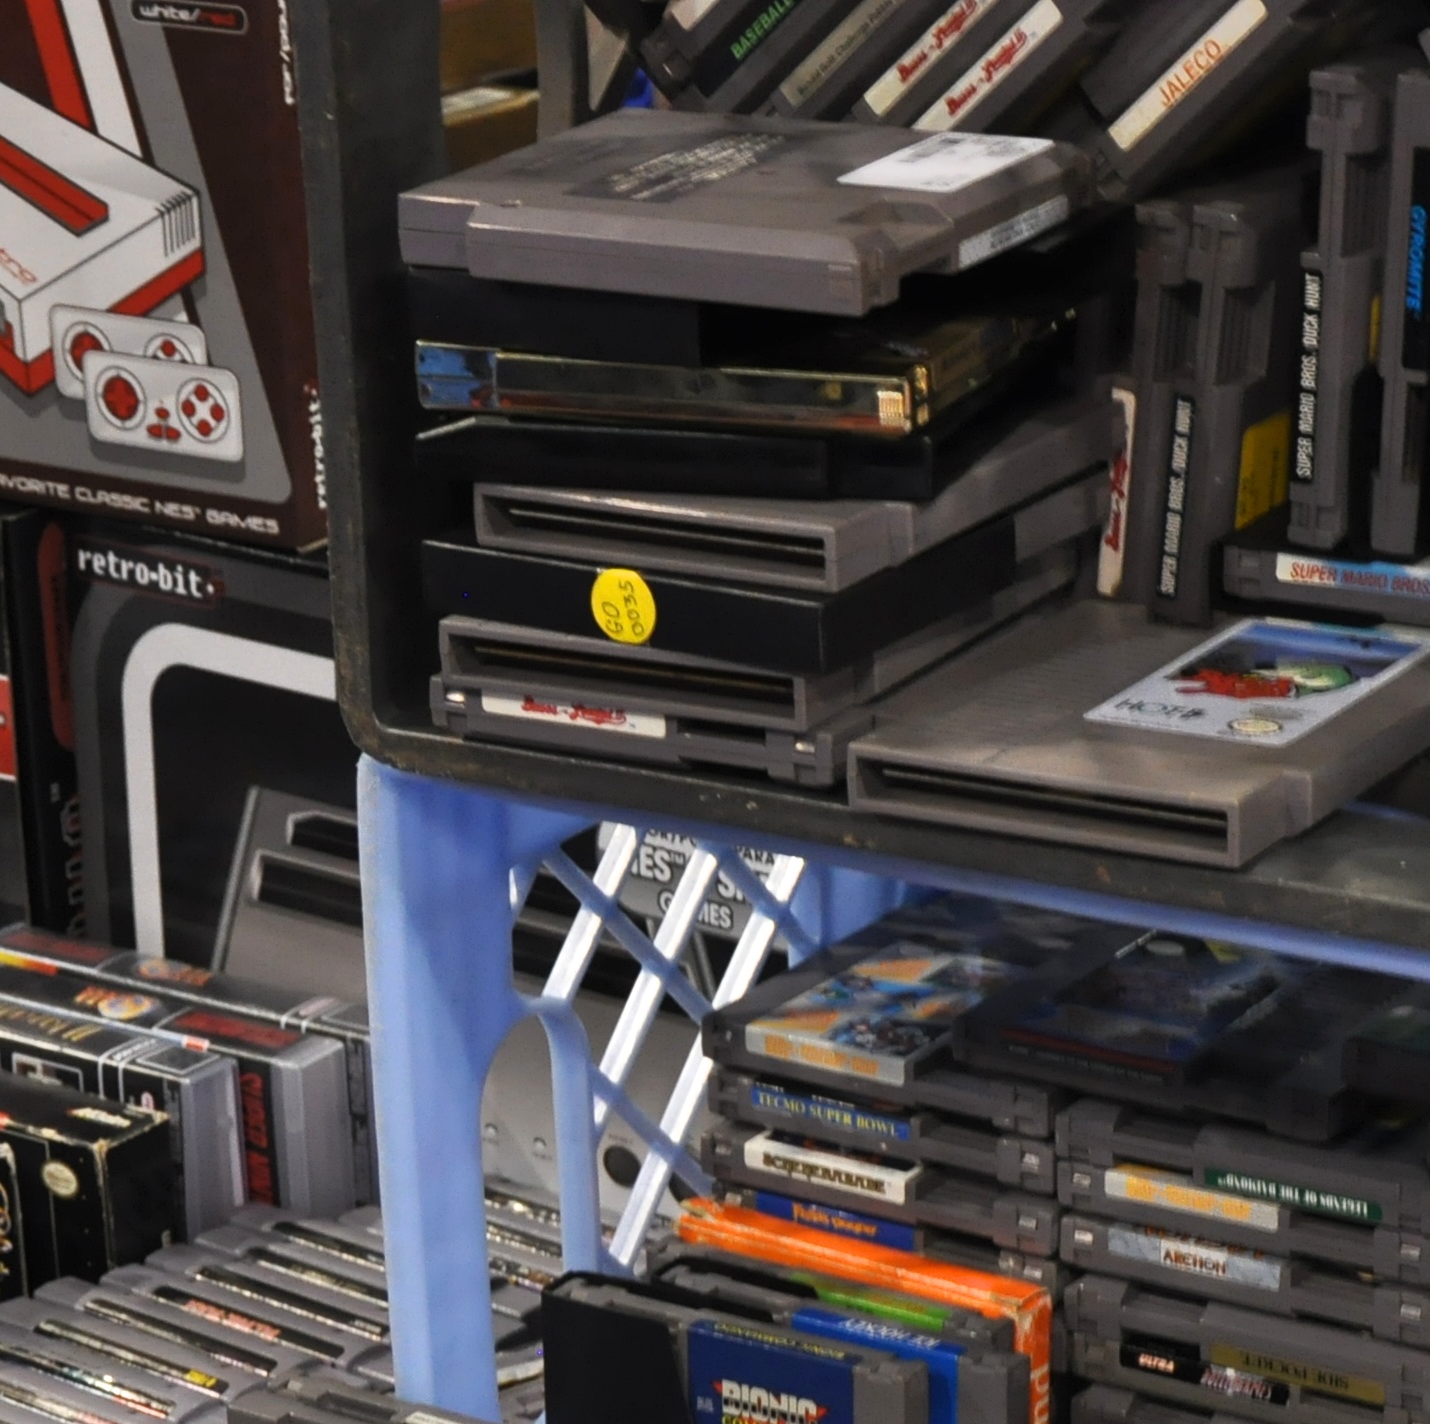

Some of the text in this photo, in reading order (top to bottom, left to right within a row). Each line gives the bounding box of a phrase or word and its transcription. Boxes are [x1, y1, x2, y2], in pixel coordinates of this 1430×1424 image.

[1159, 38, 1224, 108] JALECO
[1296, 274, 1323, 481] SUPER MARIO DUCK HUNT
[75, 485, 151, 514] CLASSIC
[206, 507, 280, 534] GAMES
[1289, 561, 1338, 583] SUPER
[809, 1101, 853, 1126] SUPER
[1163, 1249, 1227, 1276] ARCHON
[1242, 1353, 1349, 1391] SIDE POCKET
